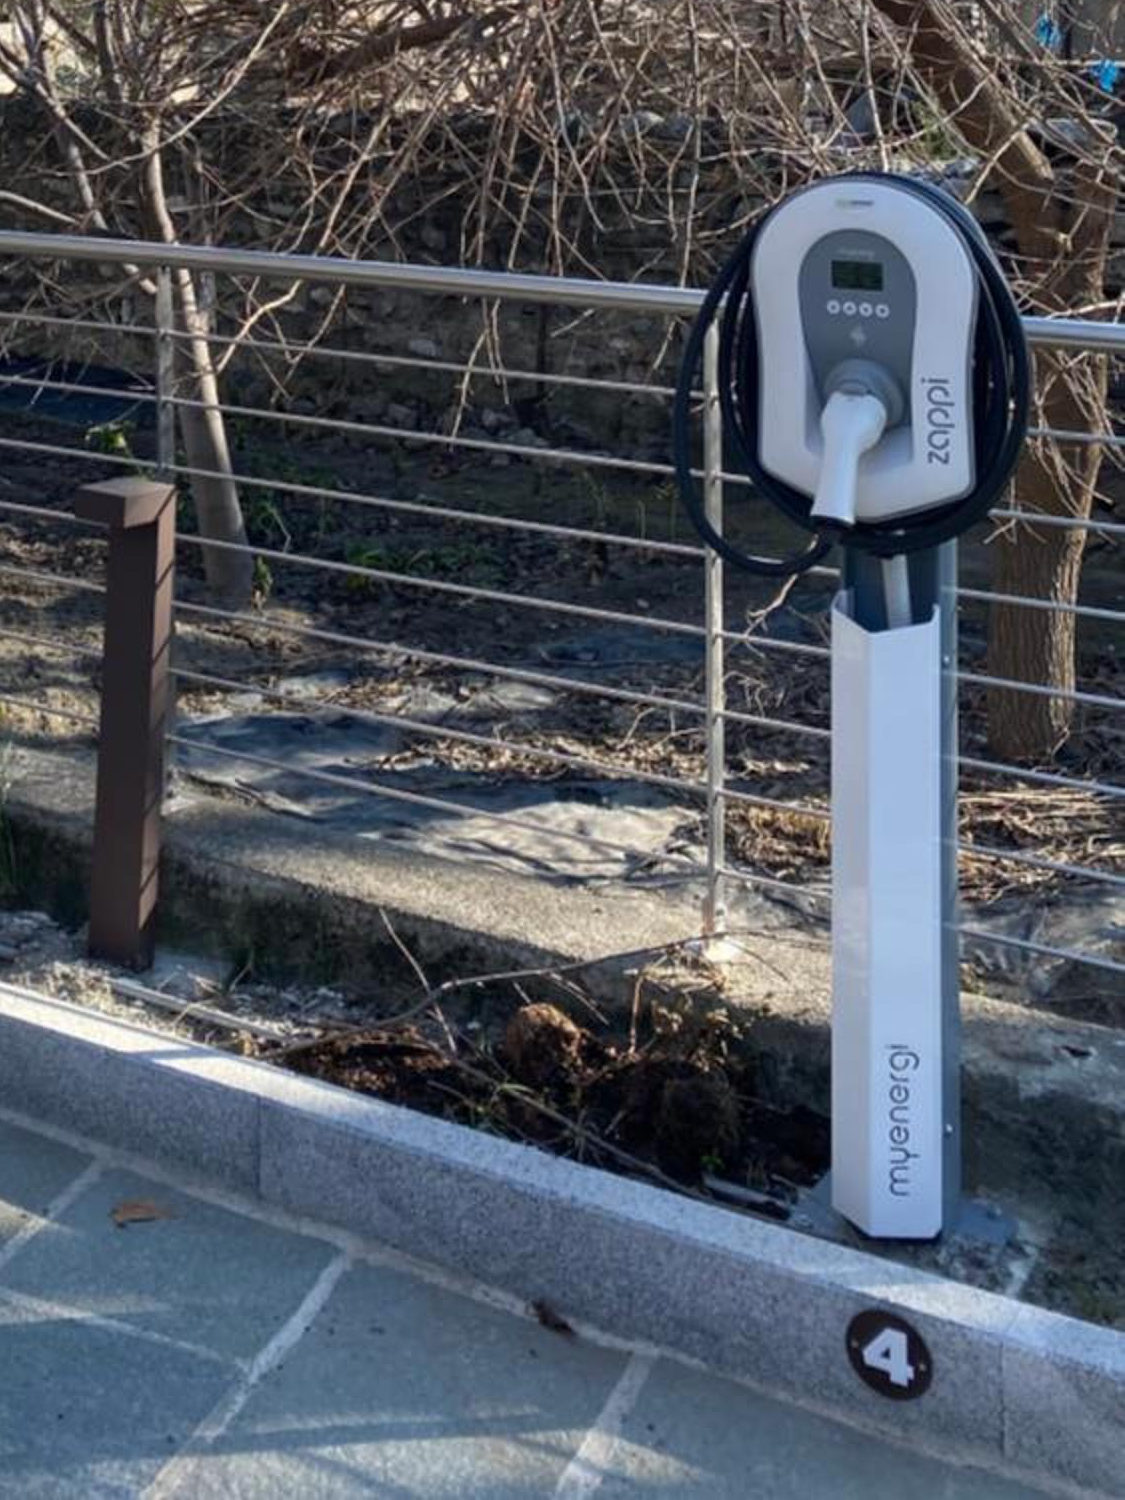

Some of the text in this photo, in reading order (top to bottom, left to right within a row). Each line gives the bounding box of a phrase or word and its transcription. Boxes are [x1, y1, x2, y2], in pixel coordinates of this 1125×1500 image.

[921, 376, 955, 465] zappi
[886, 1044, 919, 1197] myenergi
[862, 1328, 916, 1388] 4
